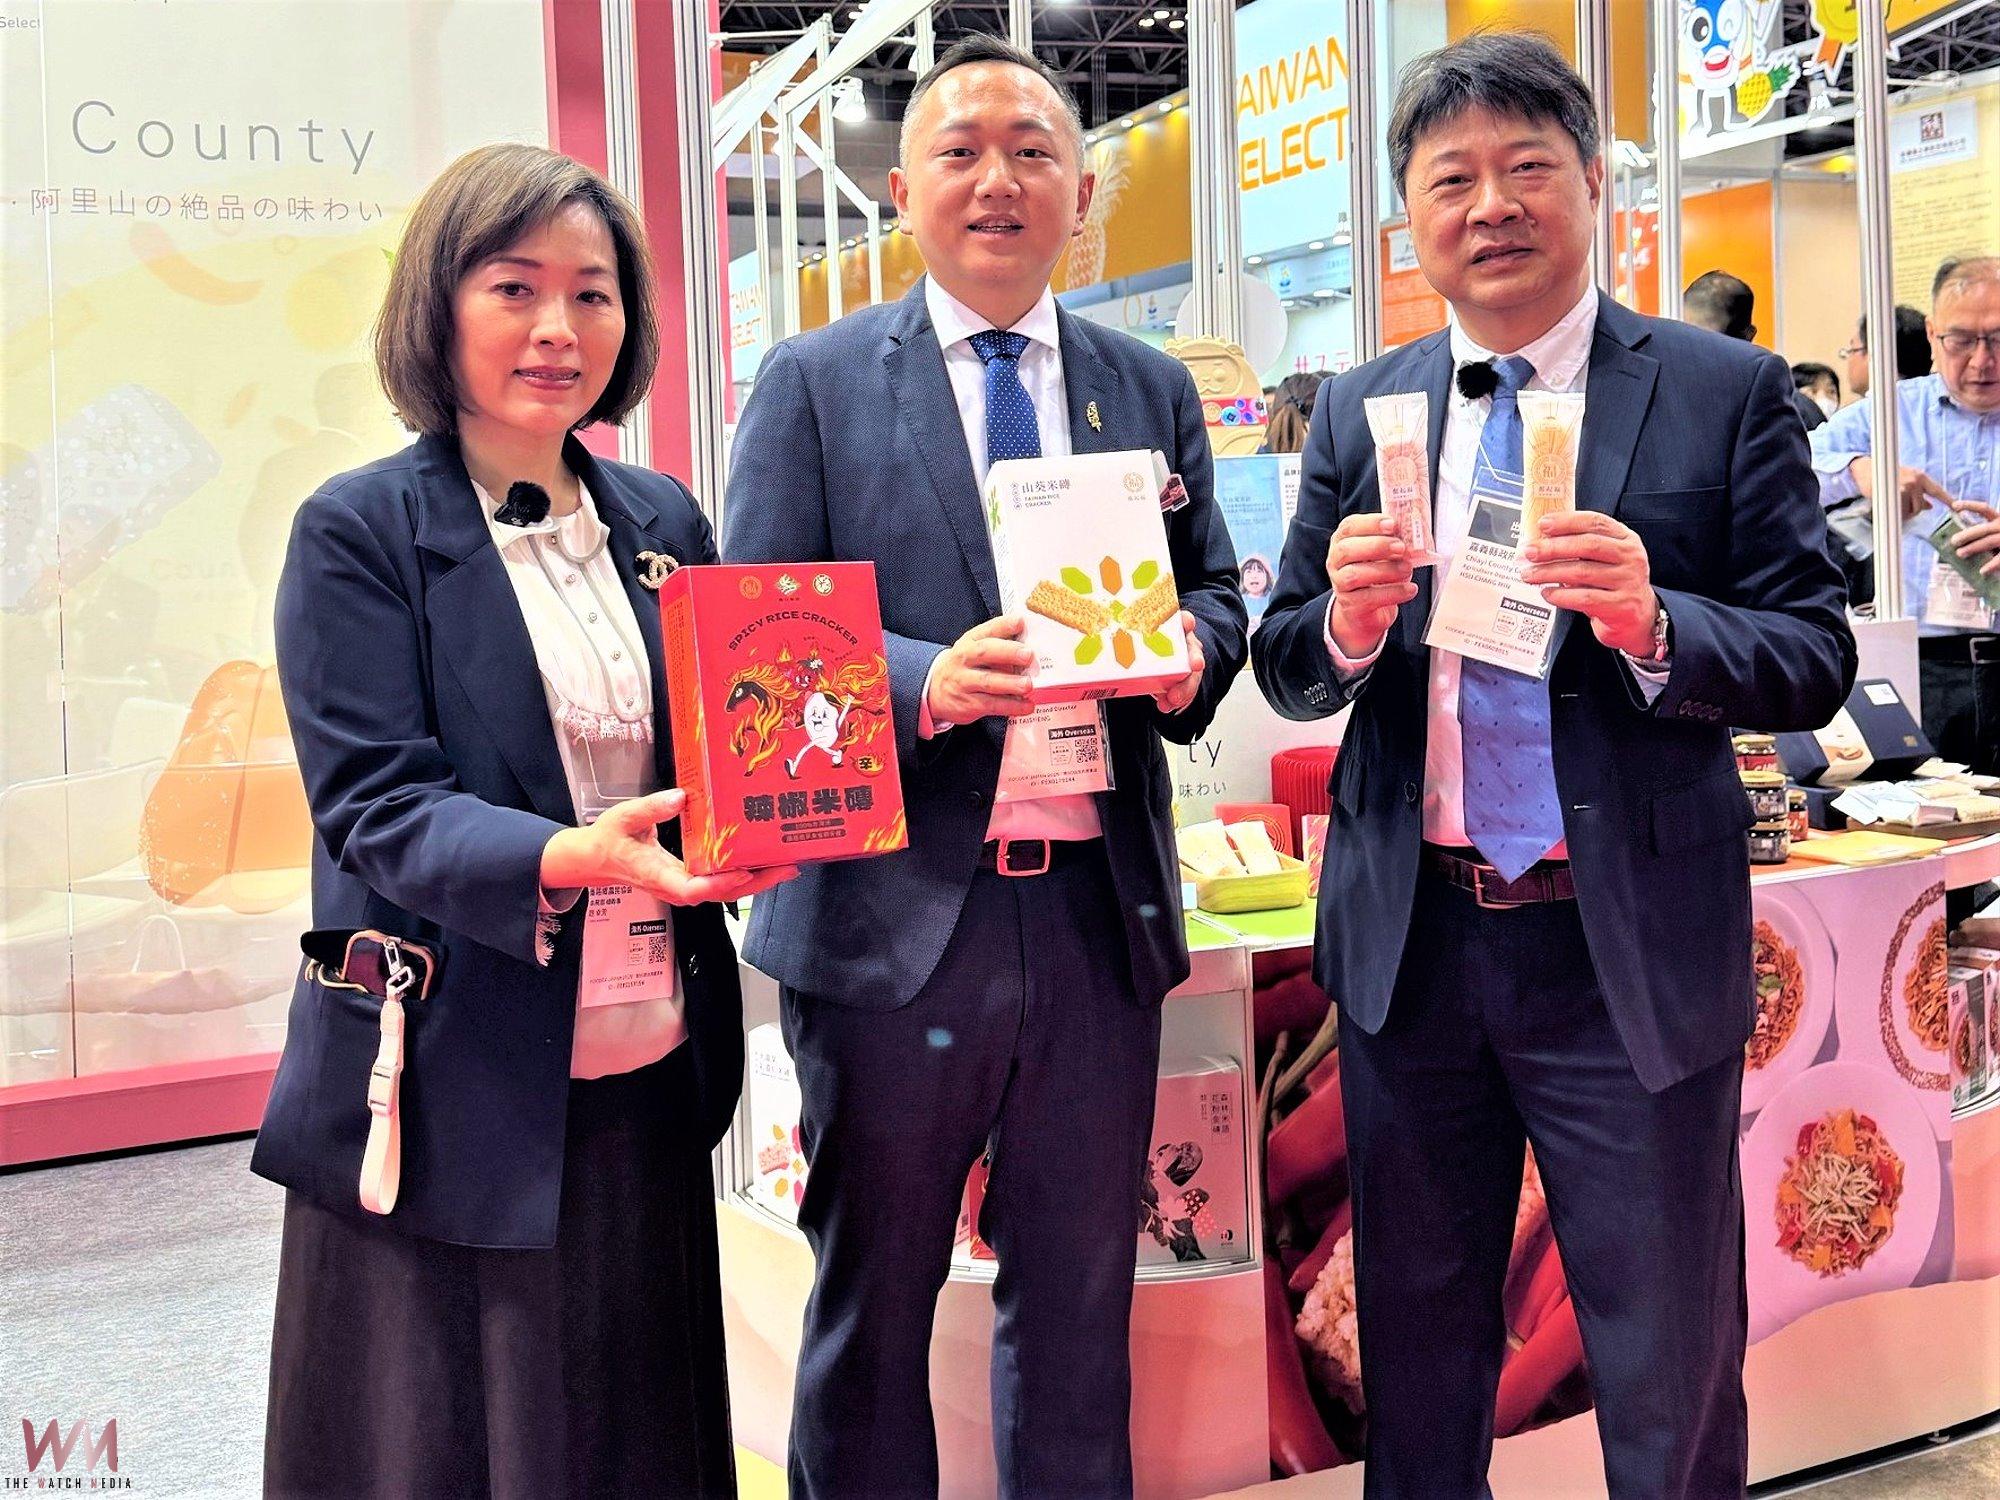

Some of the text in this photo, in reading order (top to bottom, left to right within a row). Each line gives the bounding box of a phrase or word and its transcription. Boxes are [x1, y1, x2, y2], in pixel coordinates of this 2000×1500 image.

[1236, 36, 1349, 119] AIWAN
[72, 100, 374, 175] County
[1238, 106, 1349, 191] ELECT
[728, 618, 764, 651] SPICY
[766, 610, 800, 625] RICE
[802, 610, 859, 647] CRACKER
[1517, 603, 1549, 619] Overseas
